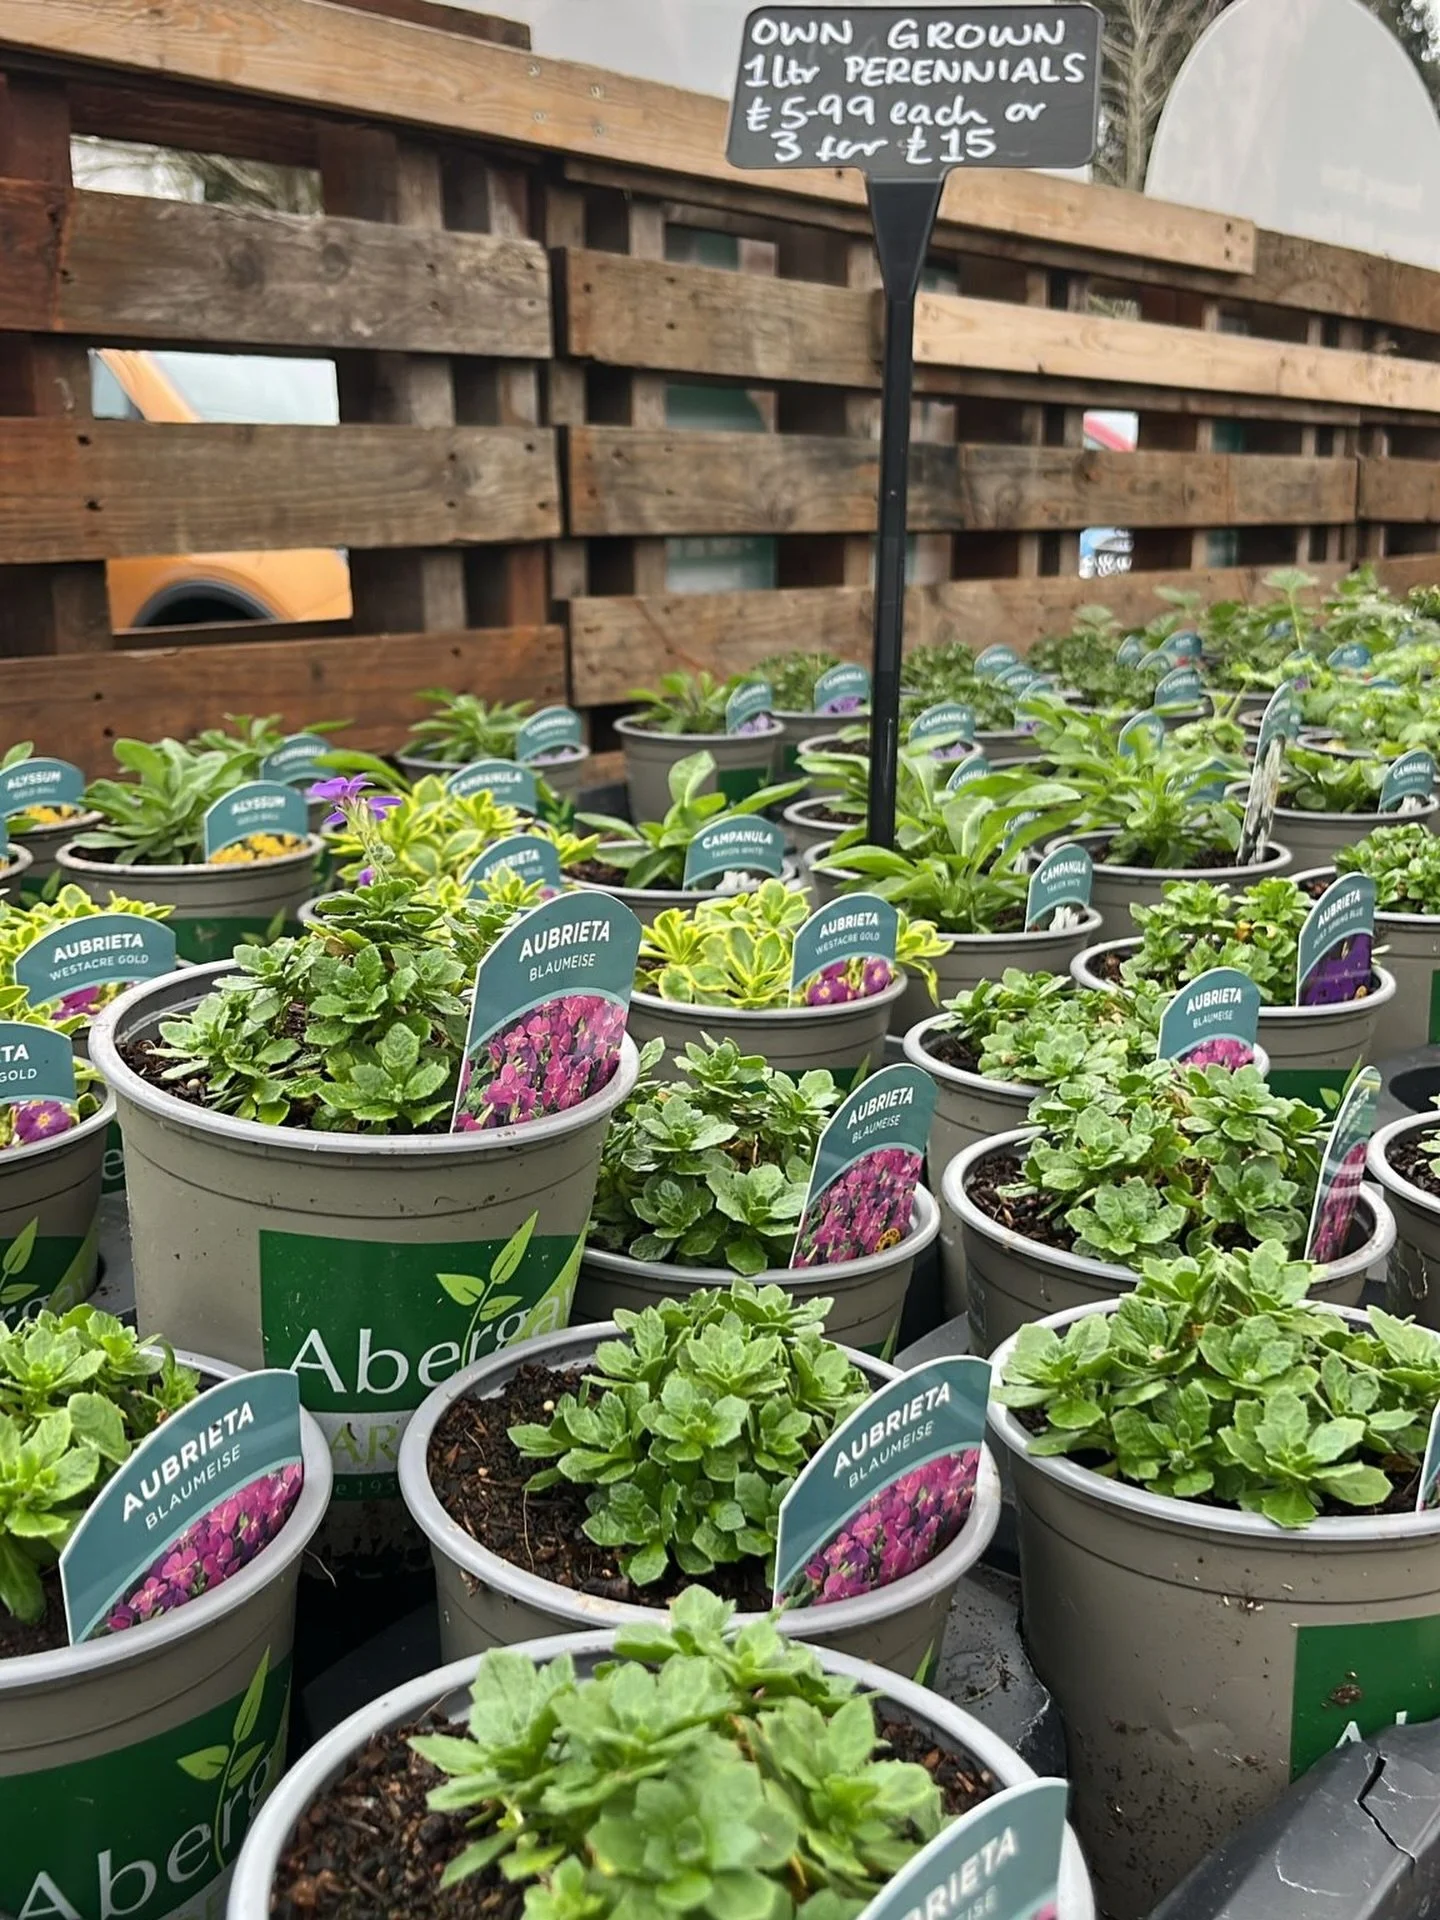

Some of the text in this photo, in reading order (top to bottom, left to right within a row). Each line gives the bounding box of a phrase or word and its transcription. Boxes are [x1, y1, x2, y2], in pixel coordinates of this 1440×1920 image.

[751, 18, 1066, 50] OWN GROWN
[744, 53, 1087, 89] 1ltr PERENNIALS
[890, 95, 988, 127] each
[1005, 101, 1046, 124] or
[770, 126, 997, 165] 3 for £15
[7, 770, 62, 790] ALYSSUM
[451, 772, 524, 795] CAMPANULA
[231, 796, 286, 815] ALYSSUM
[702, 830, 773, 850] CAMPANULA
[1041, 861, 1086, 884] CAMPANULA
[1318, 889, 1361, 929] AUBRIETA
[820, 912, 880, 939] AUBRIETA
[53, 933, 144, 964] AUBRIETA
[519, 920, 611, 963] AUBRIETA
[815, 932, 880, 955] WESTACRE GOLD
[49, 953, 150, 982] WESTACRE GOLD
[529, 953, 597, 982] BLAUMEISE
[1185, 987, 1242, 1015] AUBRIETA
[1192, 1010, 1235, 1030] BLAUMEISE
[0, 1043, 30, 1064] TA
[0, 1068, 38, 1084] GOLD
[847, 1087, 914, 1129] AUBRIETA
[852, 1114, 902, 1144] BLAUMEISE
[833, 1382, 950, 1478] AUBRIETA
[122, 1401, 255, 1523] AUBRIETA
[849, 1421, 935, 1489] BLAUMEISE
[145, 1444, 241, 1531] BLAUMEISE
[901, 1826, 1018, 1920] RIETA
